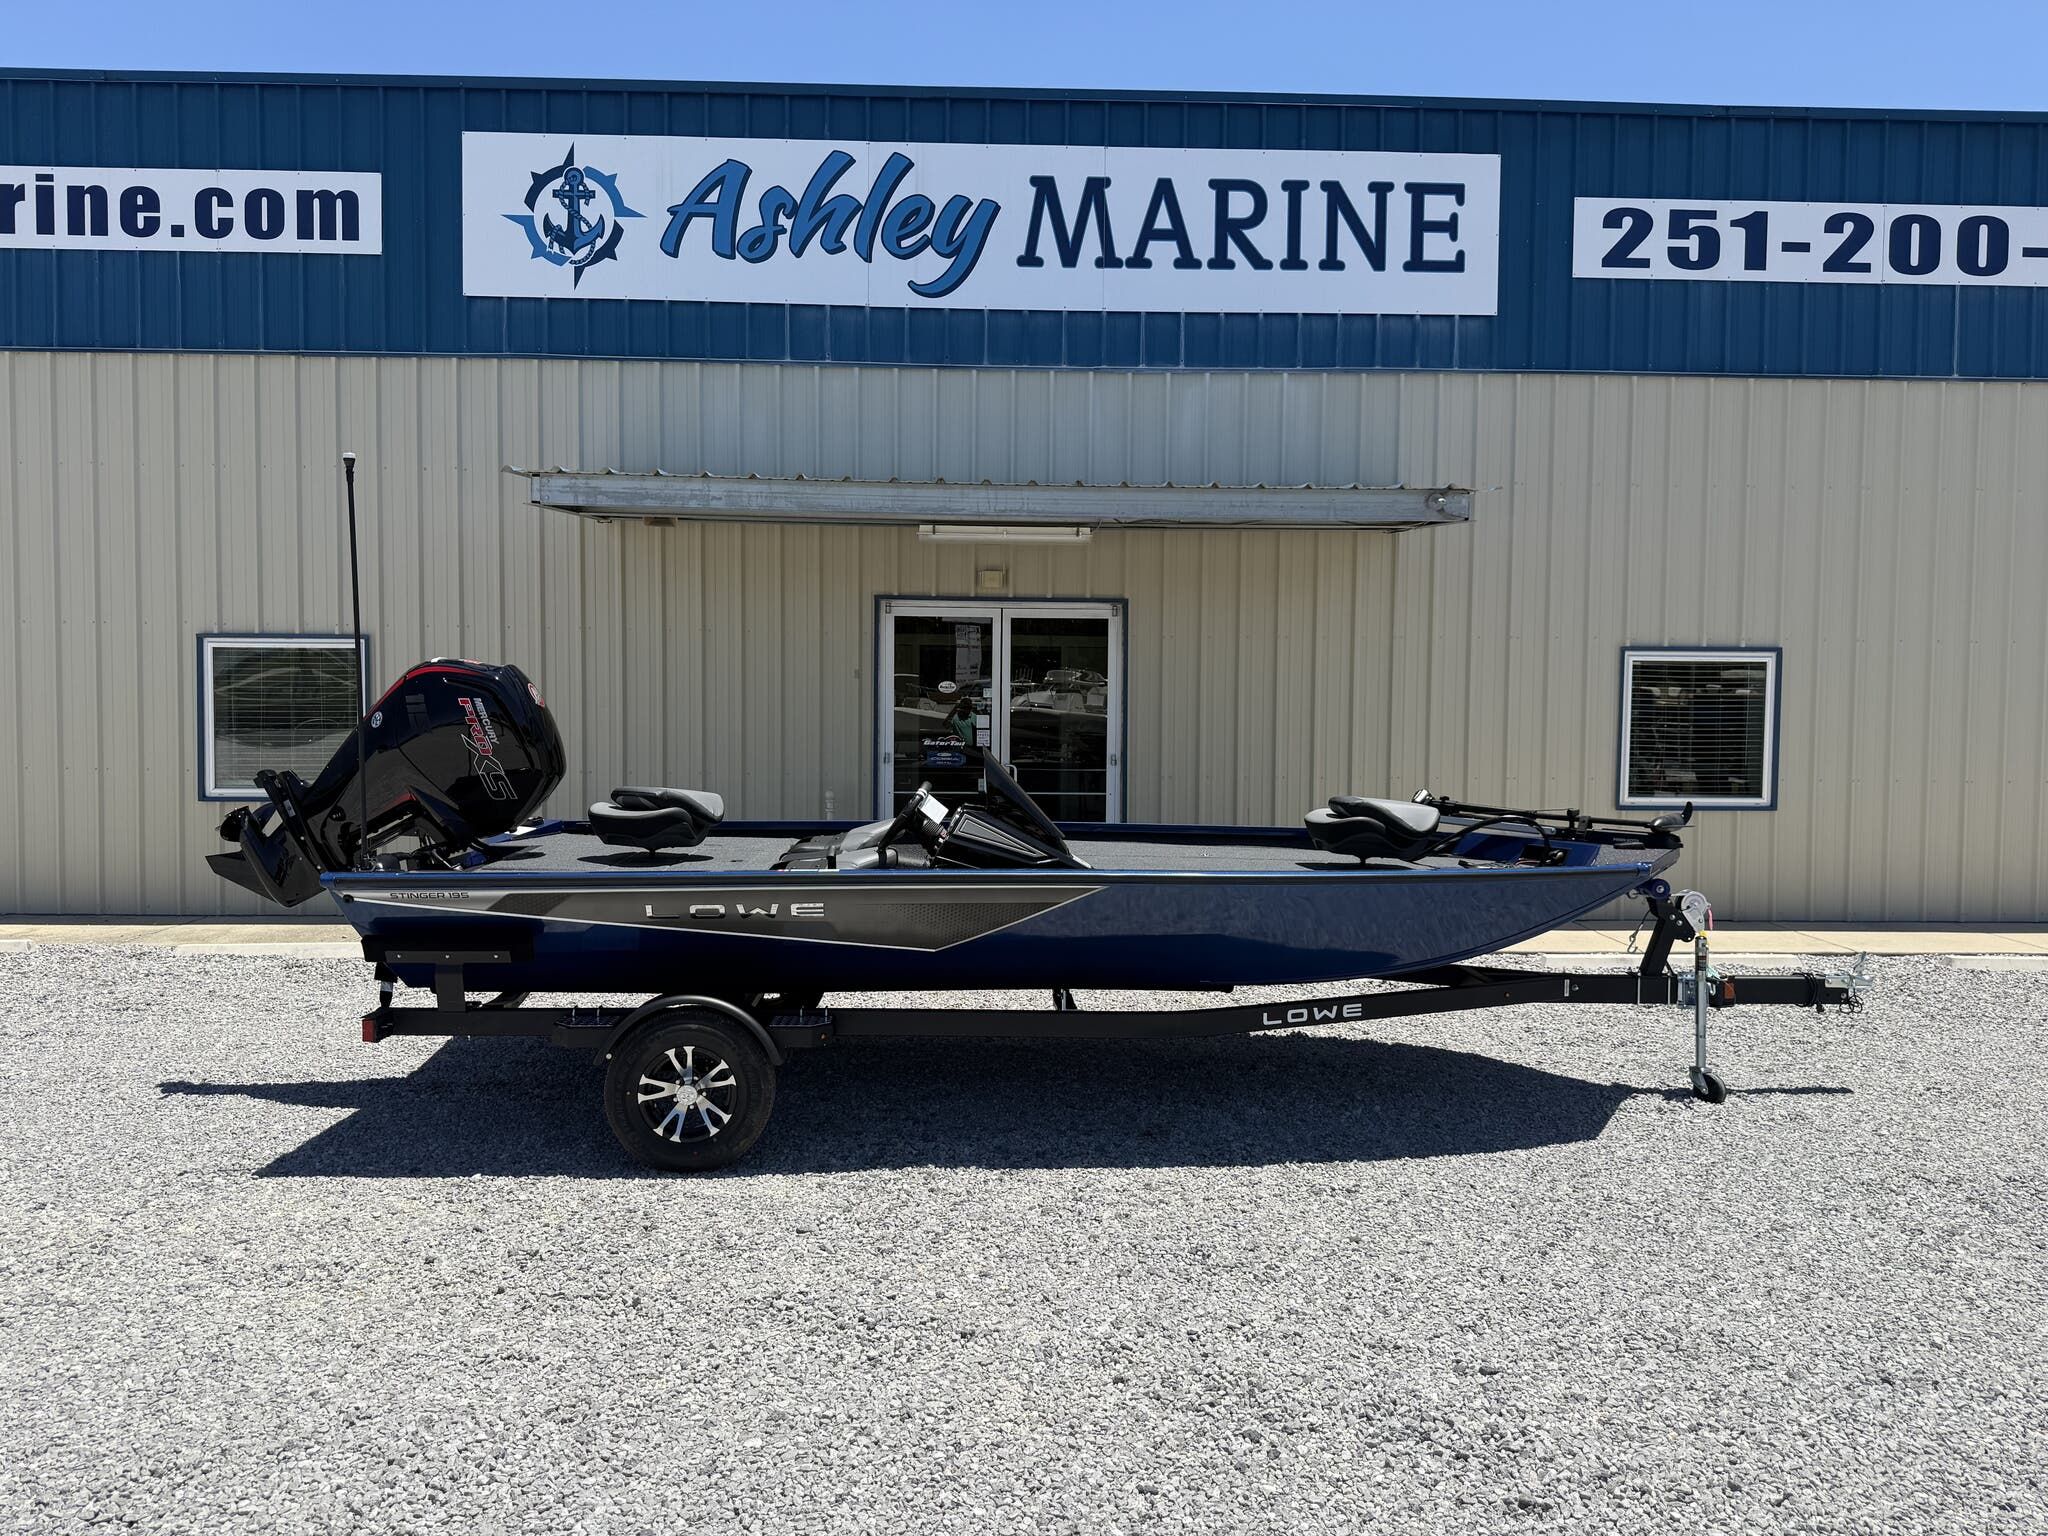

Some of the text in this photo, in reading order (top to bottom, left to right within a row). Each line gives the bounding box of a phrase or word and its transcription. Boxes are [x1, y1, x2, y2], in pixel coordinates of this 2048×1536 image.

[0, 173, 360, 241] rine.com
[660, 150, 1466, 298] Ashley MARINE
[1601, 207, 2048, 276] 251-200-
[458, 697, 518, 800] PRO XS
[473, 697, 500, 745] MERCURY
[645, 903, 825, 919] LOWE
[1262, 1003, 1362, 1026] LOWE
